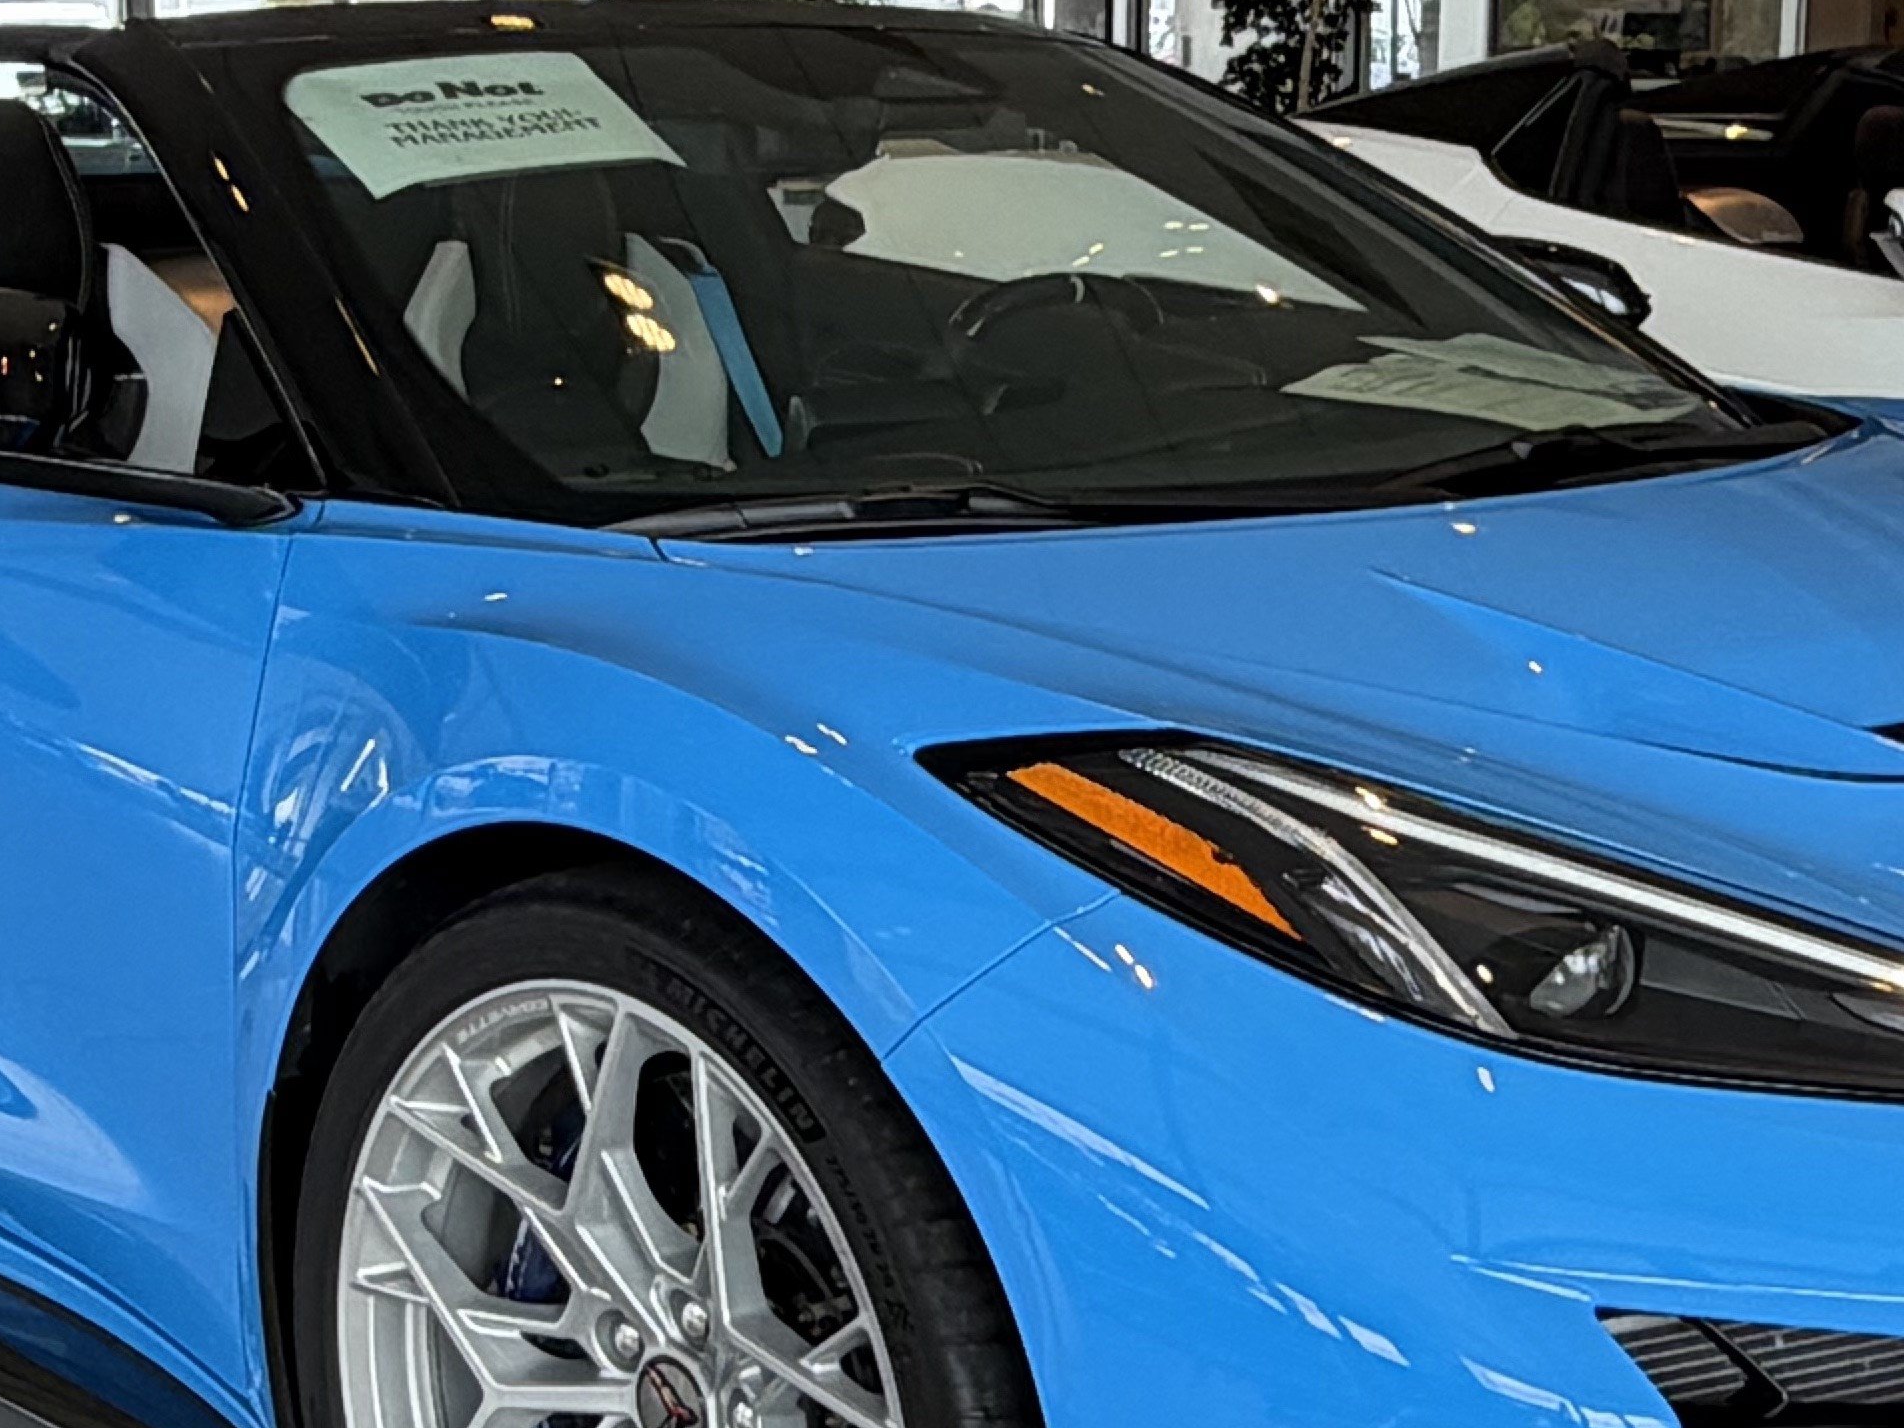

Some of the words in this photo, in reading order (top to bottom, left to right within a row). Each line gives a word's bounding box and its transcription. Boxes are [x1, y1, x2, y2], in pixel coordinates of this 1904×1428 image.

[360, 91, 435, 108] Do
[433, 80, 545, 100] Not
[384, 118, 494, 134] THANK
[390, 117, 600, 148] MANAGEMENT
[664, 977, 815, 1131] MICHELIN
